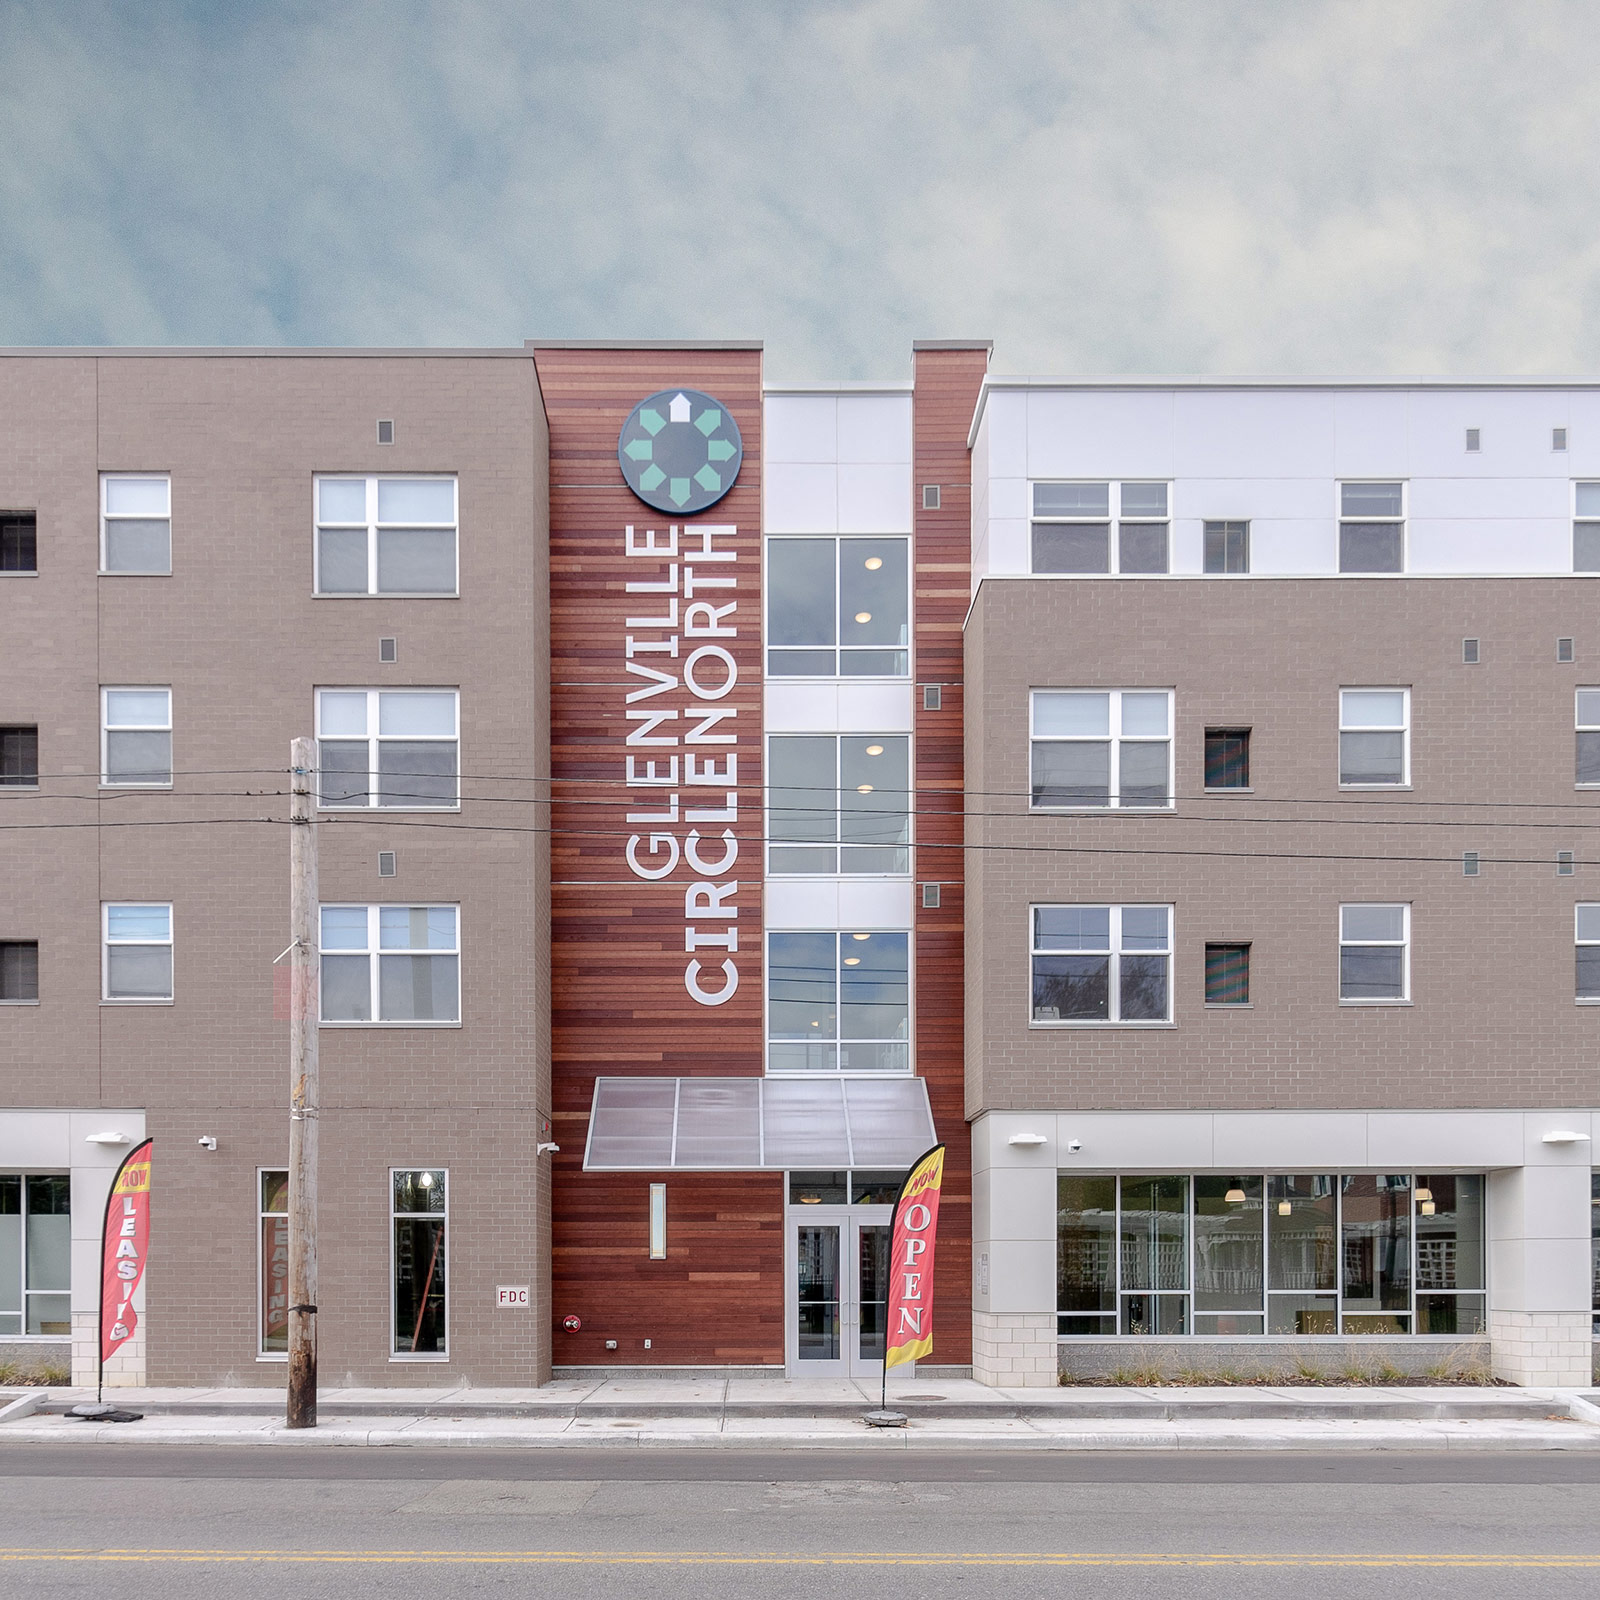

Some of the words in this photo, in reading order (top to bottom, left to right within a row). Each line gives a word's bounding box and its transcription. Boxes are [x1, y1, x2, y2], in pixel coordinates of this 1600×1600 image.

[625, 524, 680, 880] GLENVILLE
[910, 1165, 939, 1192] NOW
[500, 1291, 526, 1302] FDC
[897, 1203, 931, 1335] OPEN
